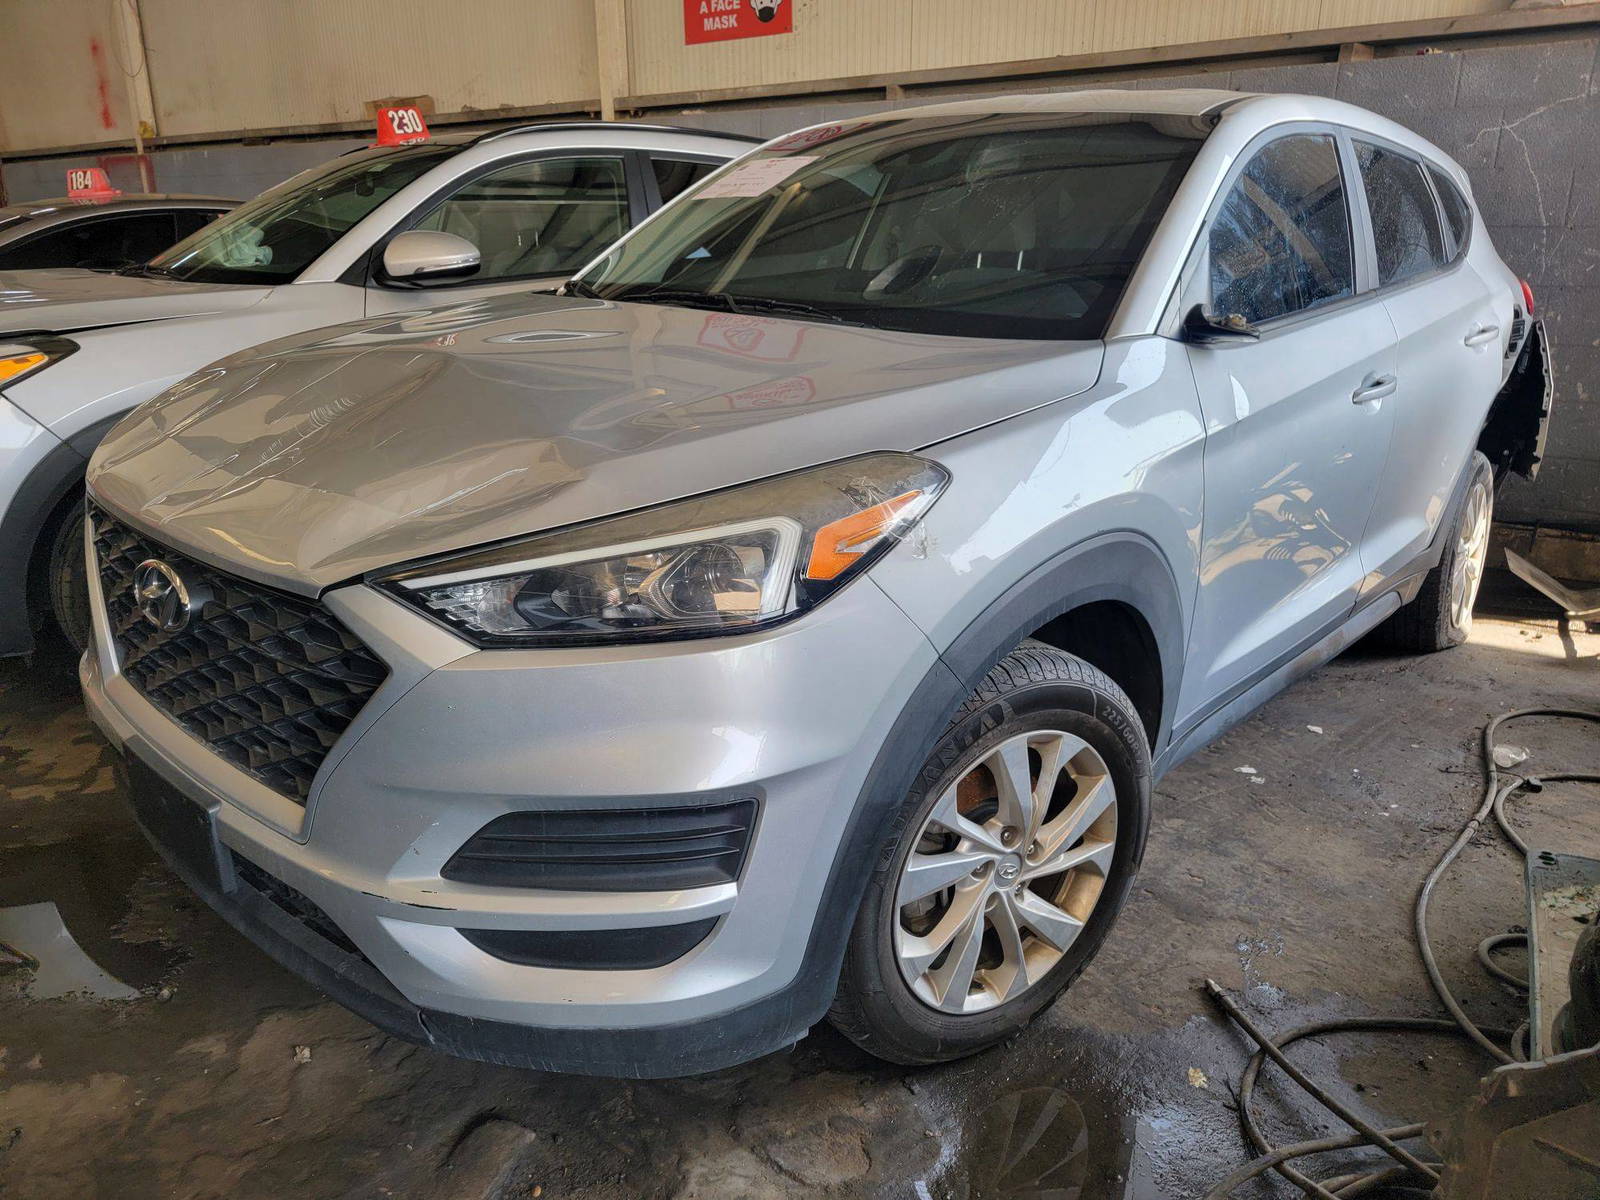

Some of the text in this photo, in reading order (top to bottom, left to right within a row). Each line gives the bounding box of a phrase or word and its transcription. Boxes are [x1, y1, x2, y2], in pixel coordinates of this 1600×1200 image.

[699, 0, 740, 14] A FACE
[703, 14, 737, 31] MASK
[388, 109, 423, 134] 230
[71, 170, 92, 190] 184
